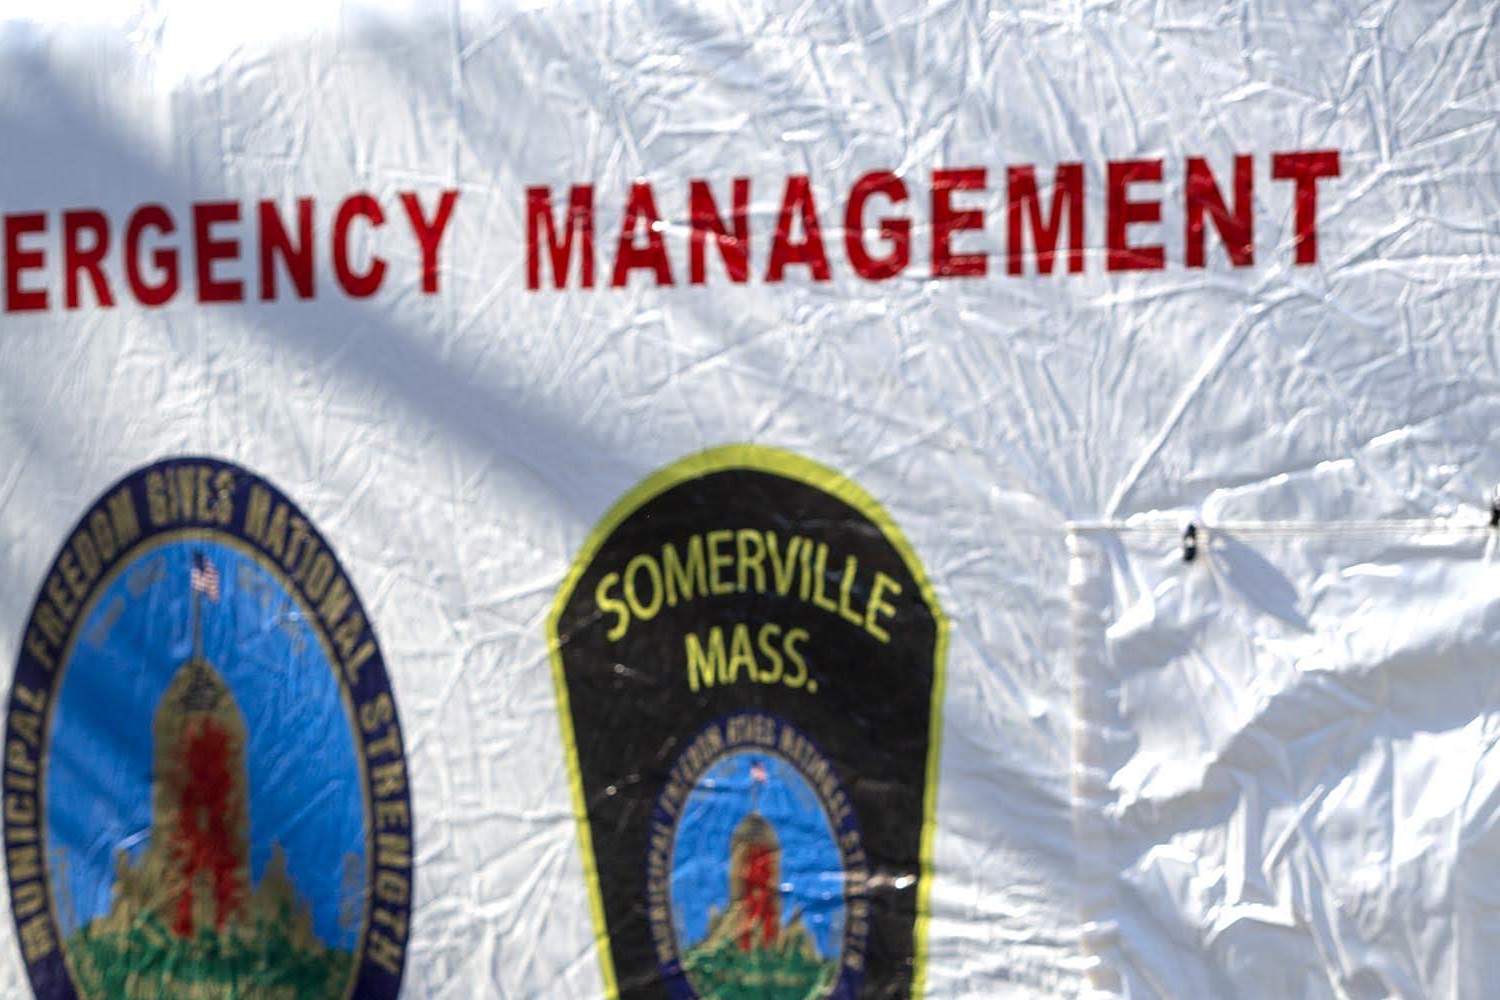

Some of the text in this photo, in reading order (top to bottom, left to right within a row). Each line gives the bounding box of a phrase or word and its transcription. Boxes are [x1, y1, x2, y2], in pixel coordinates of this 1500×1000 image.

[525, 151, 1341, 291] MANAGEMENT
[26, 487, 140, 670] FREEDOM
[146, 465, 235, 526] GIVES
[244, 483, 376, 686] NATIONAL
[594, 528, 902, 643] SOMERVILLE
[684, 622, 819, 694] MASS.
